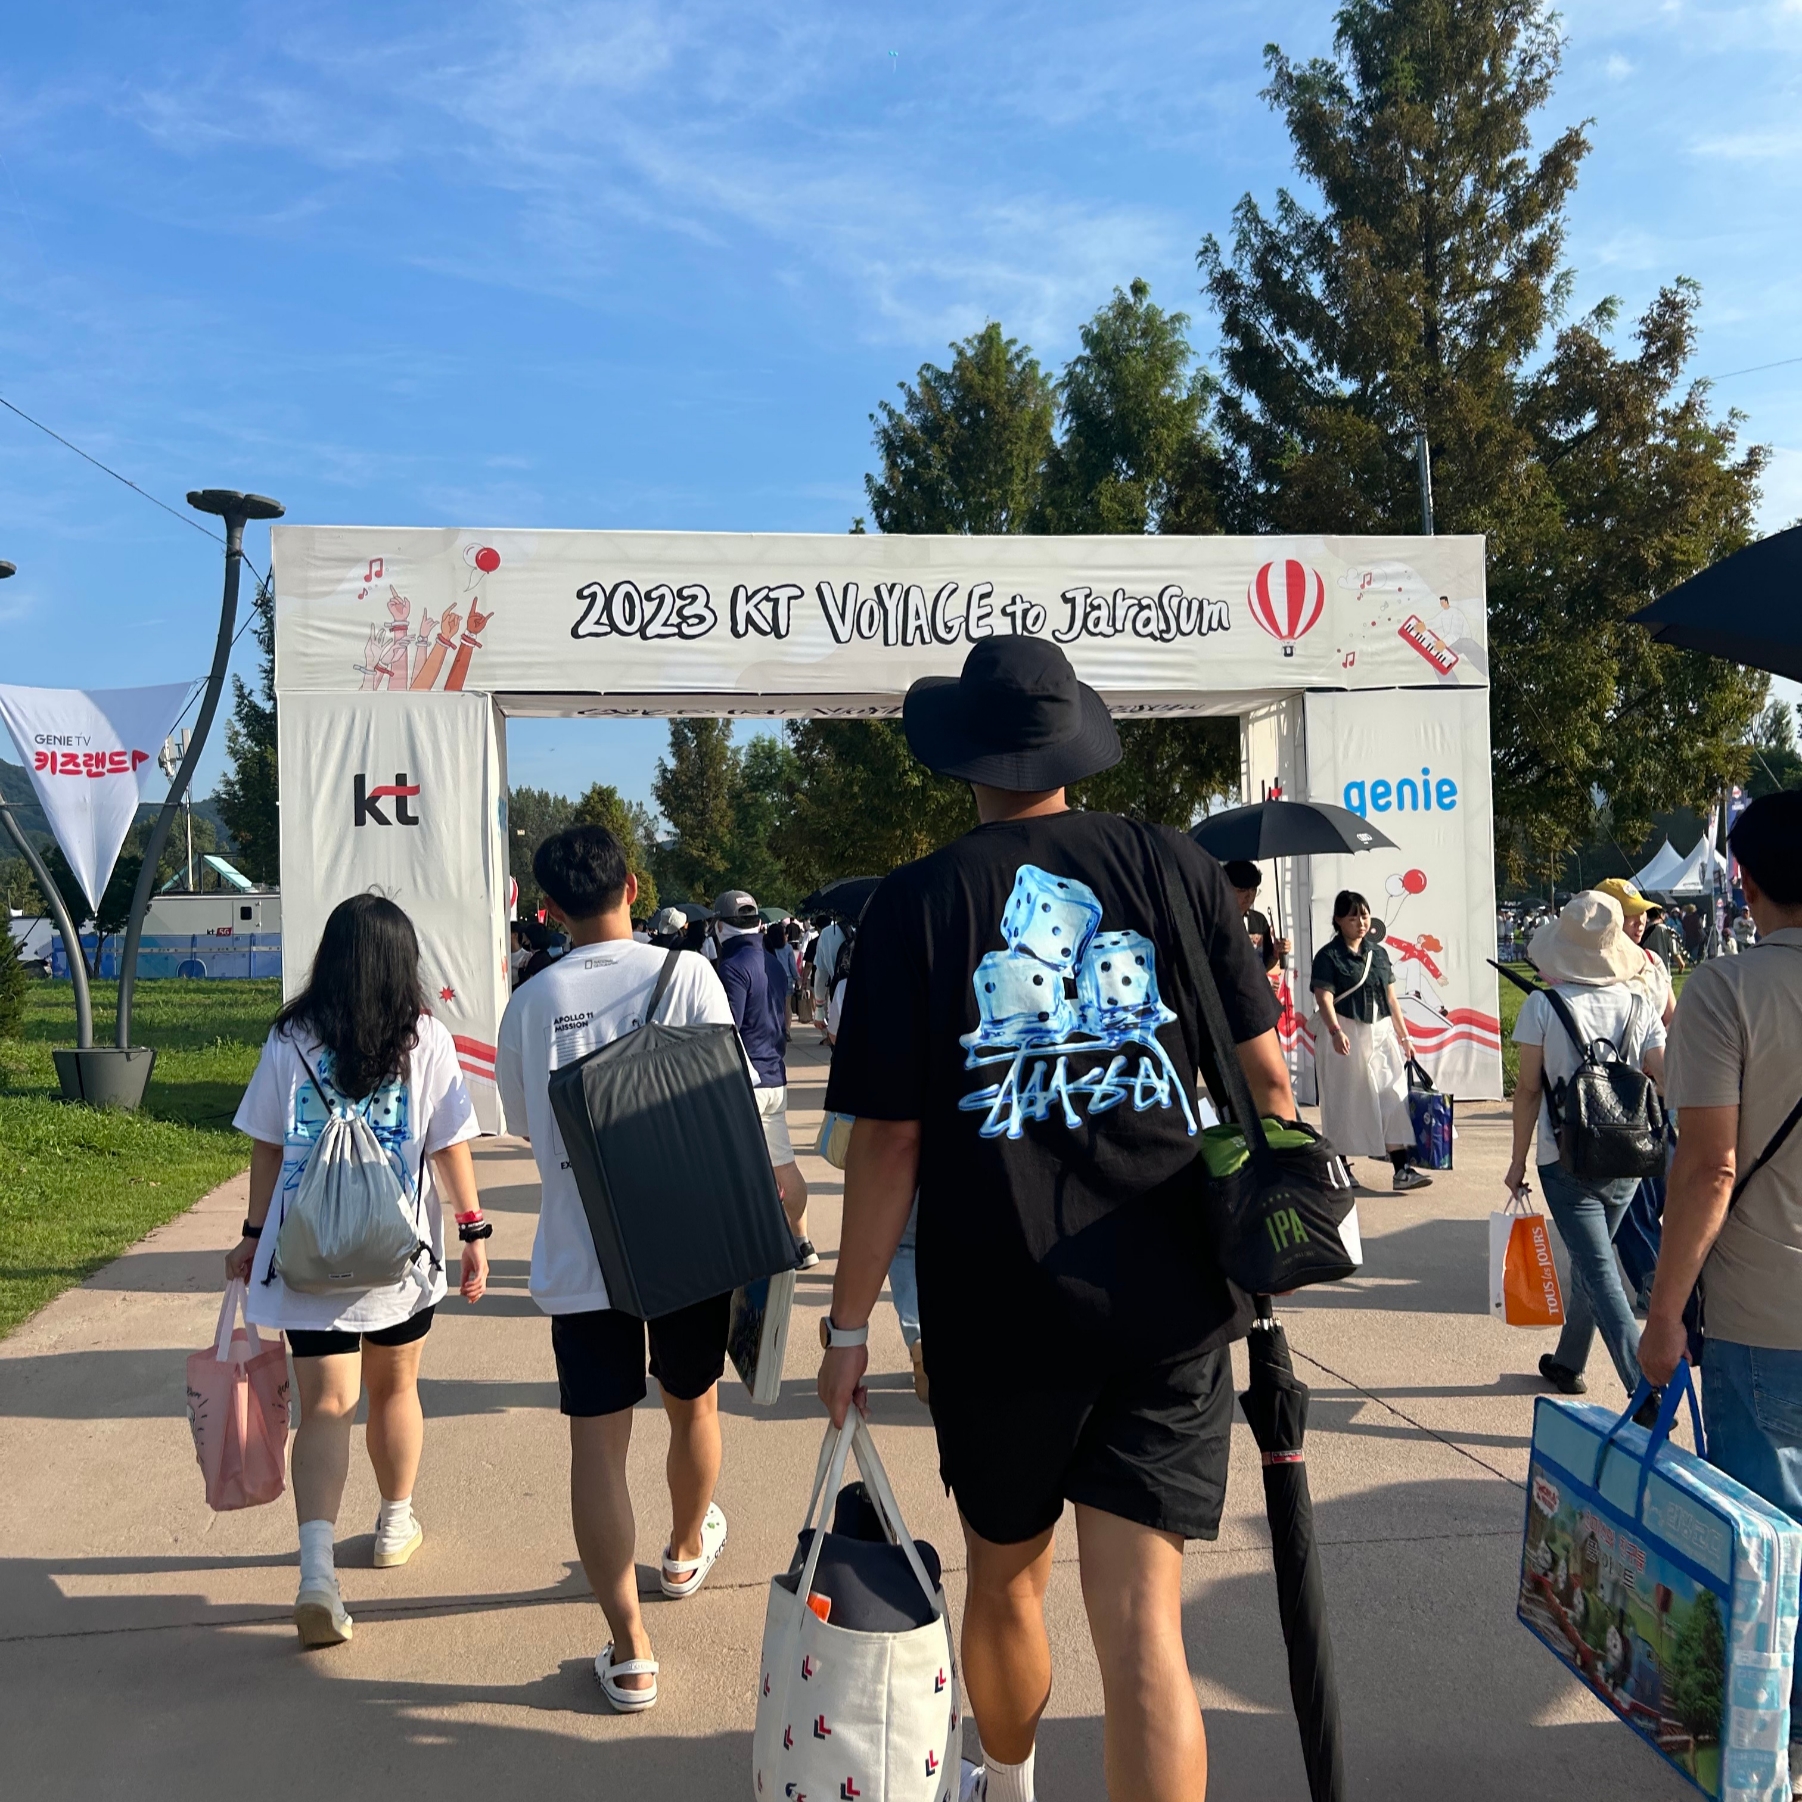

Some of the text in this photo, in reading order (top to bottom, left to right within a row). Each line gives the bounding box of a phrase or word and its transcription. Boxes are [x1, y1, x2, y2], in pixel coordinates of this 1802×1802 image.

[571, 580, 717, 640] 2023
[730, 584, 804, 639] KT
[1001, 594, 1047, 635] to
[34, 734, 91, 746] GENIE TV
[34, 750, 131, 778] 키즈랜드
[354, 773, 420, 827] kt
[1343, 766, 1458, 820] genie
[206, 928, 215, 936] kt
[553, 1013, 584, 1025] APOLLO
[554, 1021, 589, 1032] MISSION
[1265, 1207, 1310, 1253] IPA
[1532, 1226, 1559, 1316] TOUS les JOURS
